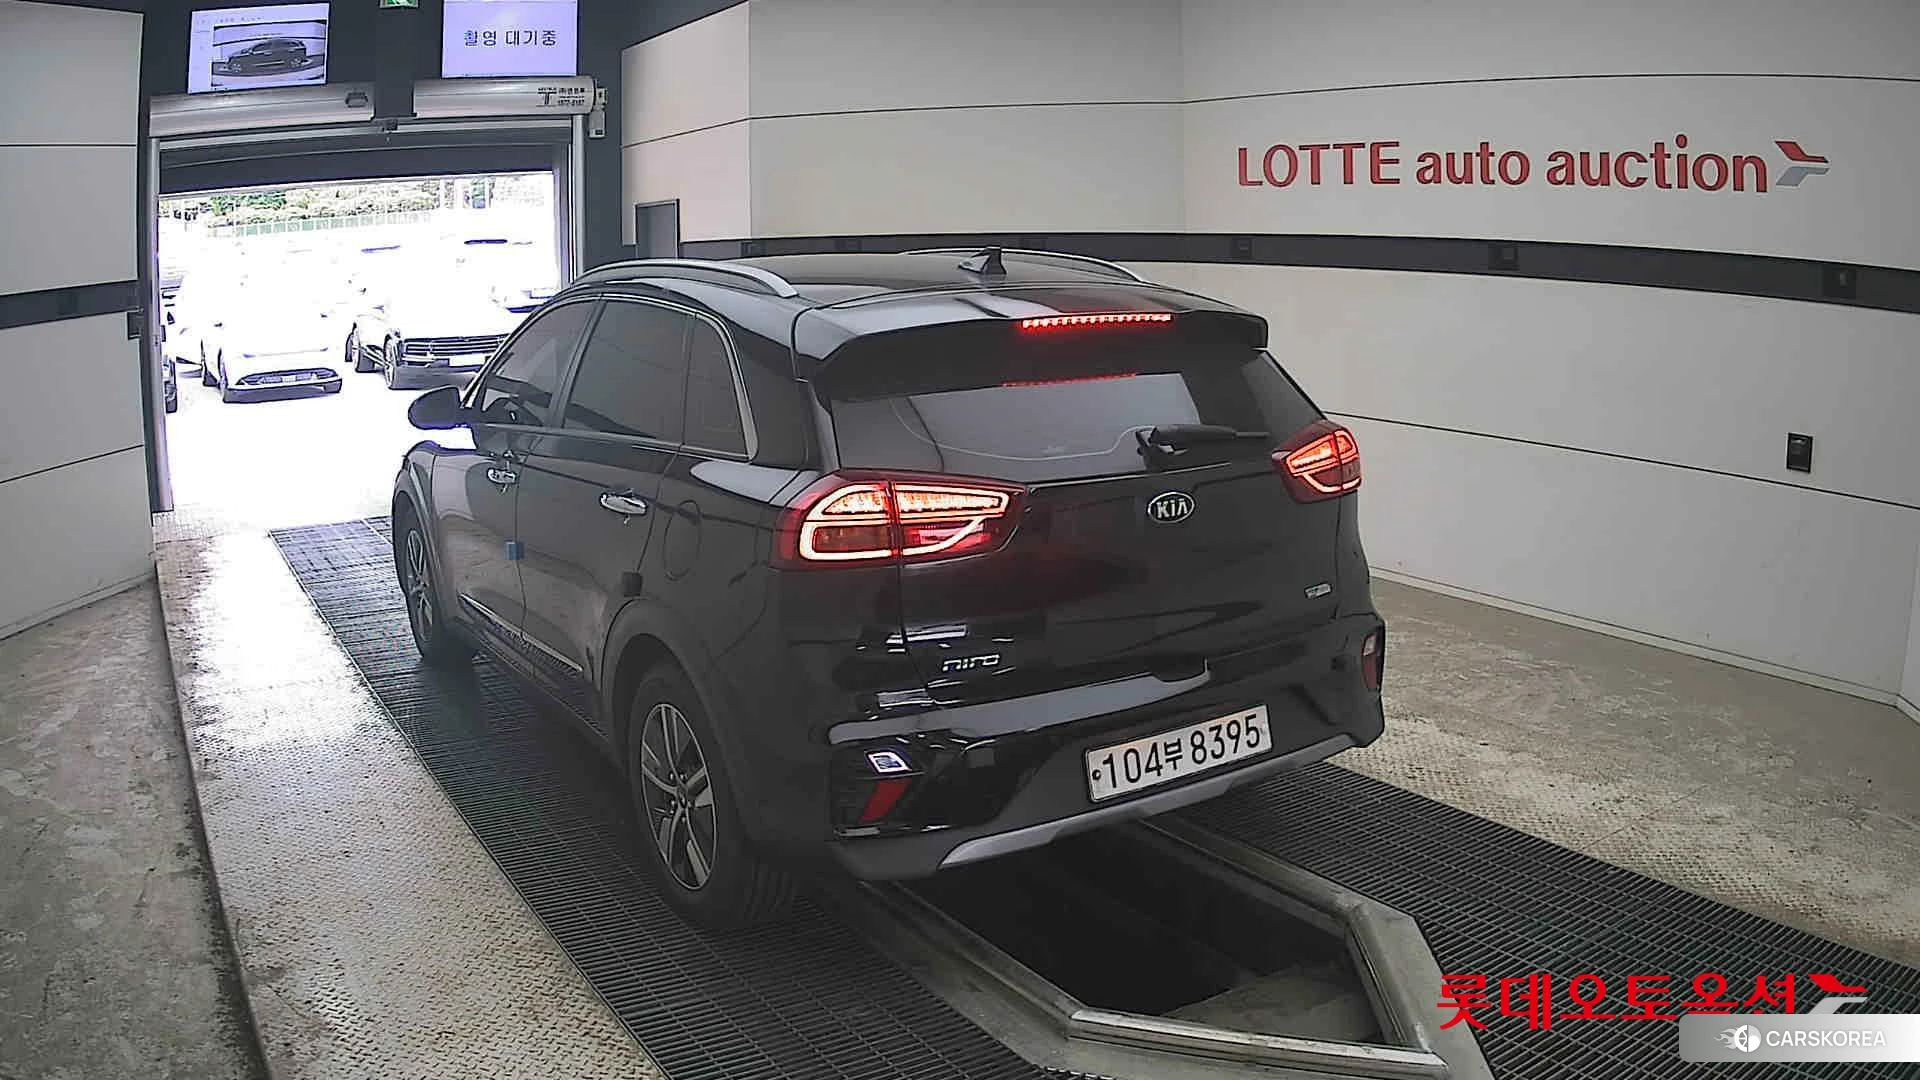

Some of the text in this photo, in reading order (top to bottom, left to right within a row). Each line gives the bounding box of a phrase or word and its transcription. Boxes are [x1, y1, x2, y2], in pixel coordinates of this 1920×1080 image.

[505, 30, 556, 46] 대기중
[1238, 134, 1768, 193] LOTTE auto auction
[1156, 498, 1188, 518] KIA
[1103, 714, 1260, 788] 104부 8395
